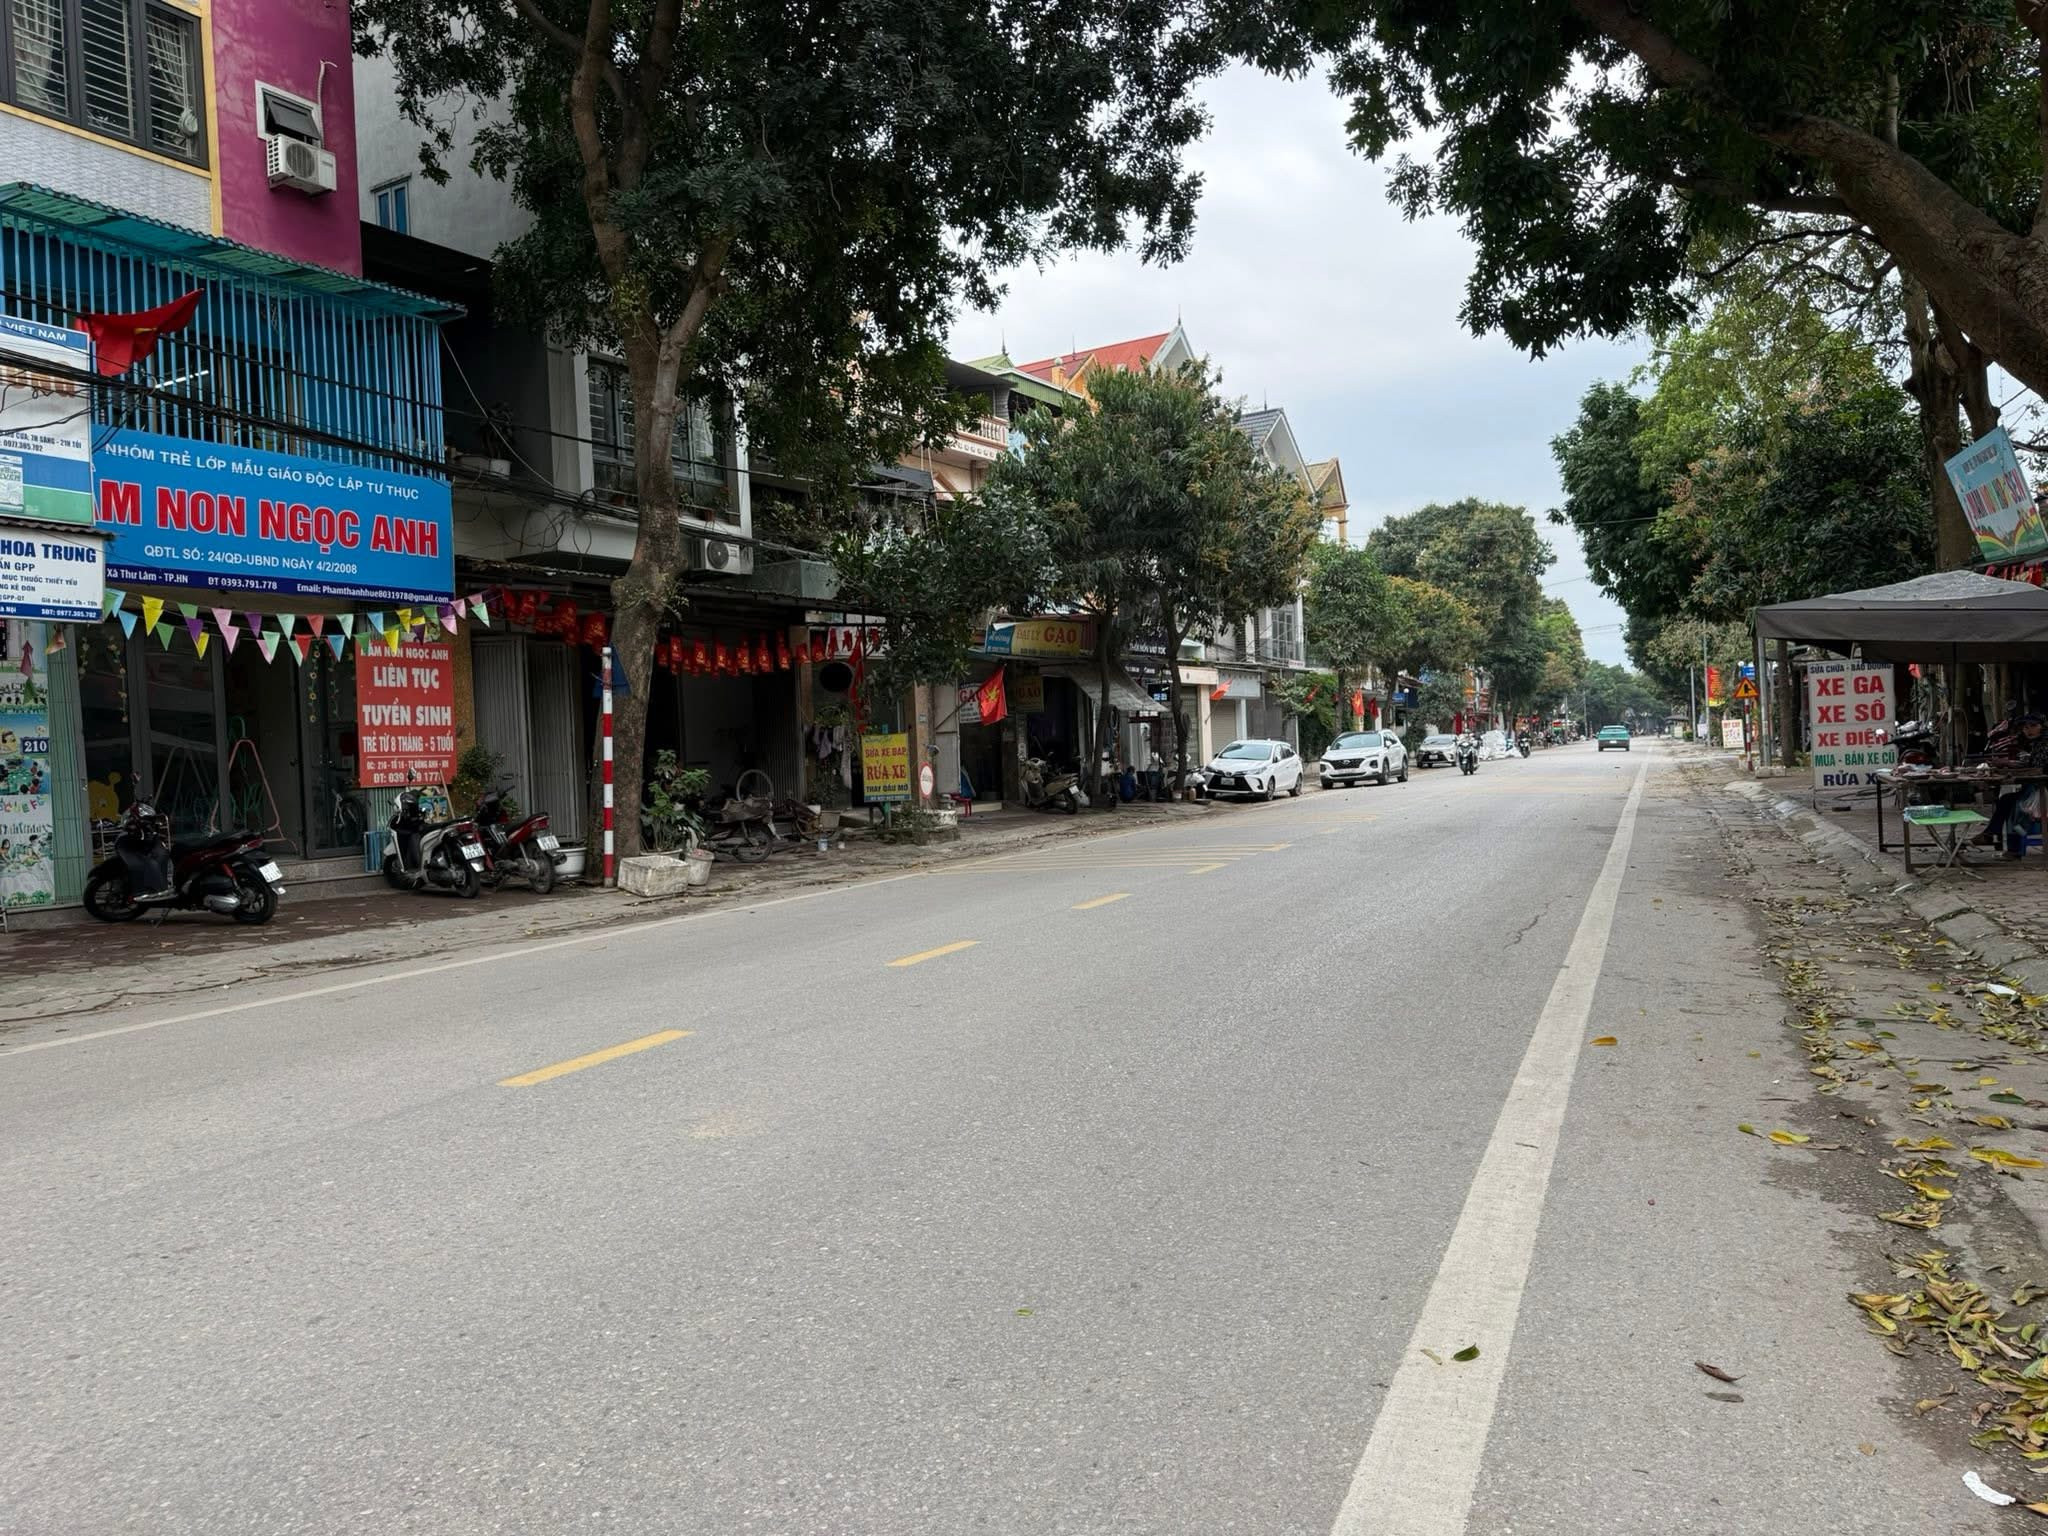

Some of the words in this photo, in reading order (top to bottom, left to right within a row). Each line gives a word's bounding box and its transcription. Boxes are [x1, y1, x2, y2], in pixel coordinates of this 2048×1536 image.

[38, 329, 66, 341] NAM
[106, 444, 154, 460] NHÓM
[160, 450, 191, 466] TRẺ
[197, 456, 226, 471] LỚP
[232, 459, 263, 476] MẪU
[268, 466, 302, 482] GIÁO
[306, 472, 334, 488] ĐỘC
[338, 476, 363, 492] LẬP
[366, 481, 384, 494] TƯ
[386, 484, 419, 500] THỤC
[156, 486, 247, 537] NON
[259, 499, 361, 554] NGỌC
[370, 514, 439, 559] ANH
[0, 539, 36, 558] HOA
[41, 543, 97, 563] TRUNG
[144, 545, 179, 560] QĐTL
[208, 550, 279, 567] 24/QĐ-UBND
[282, 557, 314, 570] NGÀY
[316, 561, 357, 575] 4/2/2008
[14, 562, 35, 572] GPP
[120, 569, 137, 579] Thư
[139, 570, 156, 580] Lâm
[164, 573, 188, 583] TP.HN
[208, 576, 219, 586] ĐT
[221, 578, 278, 590] 0393.791.778
[297, 584, 321, 593] Email:
[1044, 626, 1077, 647] GẠO
[406, 647, 429, 661] NGỌC
[432, 649, 448, 660] ANH
[373, 662, 408, 688] LIÊN
[412, 667, 439, 694] TỤC
[1810, 664, 1824, 674] SỬA
[1817, 678, 1845, 696] XE
[1854, 675, 1885, 694] GA
[362, 697, 411, 726] TUYỂN
[416, 705, 451, 726] SINH
[1817, 705, 1846, 724] XE
[1855, 696, 1885, 722] SỐ
[24, 741, 47, 752] 210
[362, 730, 377, 752] TRẺ
[379, 732, 389, 752] TỪ
[391, 736, 396, 752] 8
[398, 732, 424, 752] THÁNG
[430, 736, 435, 752] 5
[436, 730, 454, 752] TUỔI
[1818, 733, 1840, 747] XE
[1846, 728, 1889, 748] ĐIỆN
[881, 748, 889, 757] XE
[1815, 754, 1835, 767] MUA
[1844, 750, 1864, 765] BÁN
[1867, 752, 1879, 765] XE
[1882, 749, 1895, 764] CŨ
[388, 772, 404, 783] 039
[866, 760, 889, 780] RỬA
[892, 764, 906, 779] XE
[1823, 770, 1859, 786] RỬA
